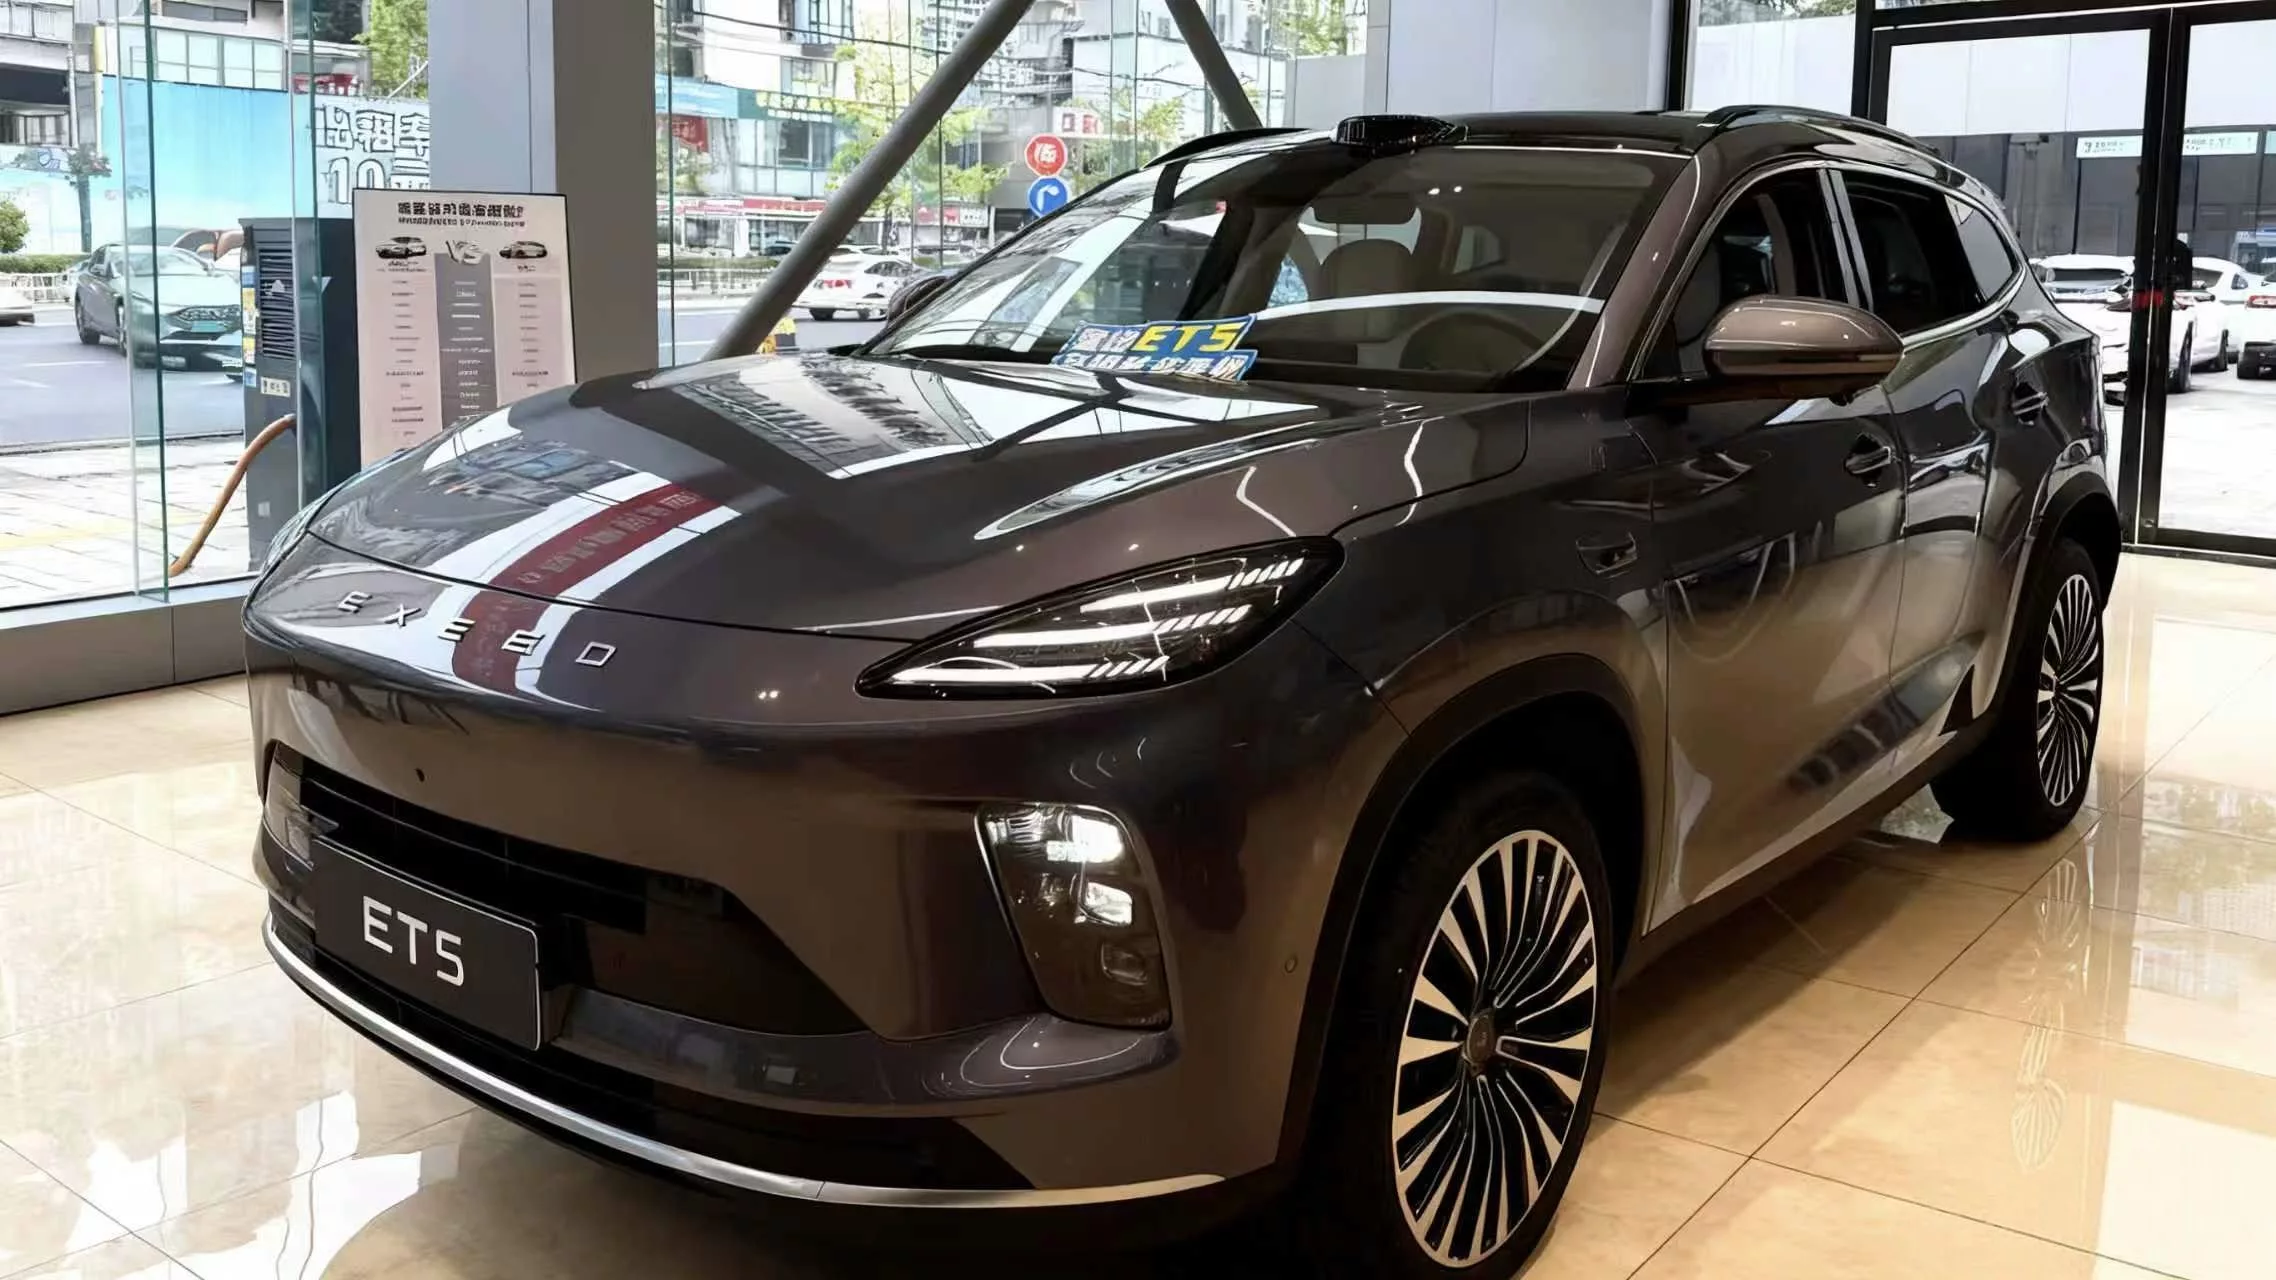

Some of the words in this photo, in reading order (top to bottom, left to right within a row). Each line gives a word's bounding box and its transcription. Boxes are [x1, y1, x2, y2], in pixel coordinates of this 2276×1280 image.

[1130, 323, 1247, 352] ET5
[337, 590, 617, 667] EXEED
[363, 895, 465, 987] ET5
